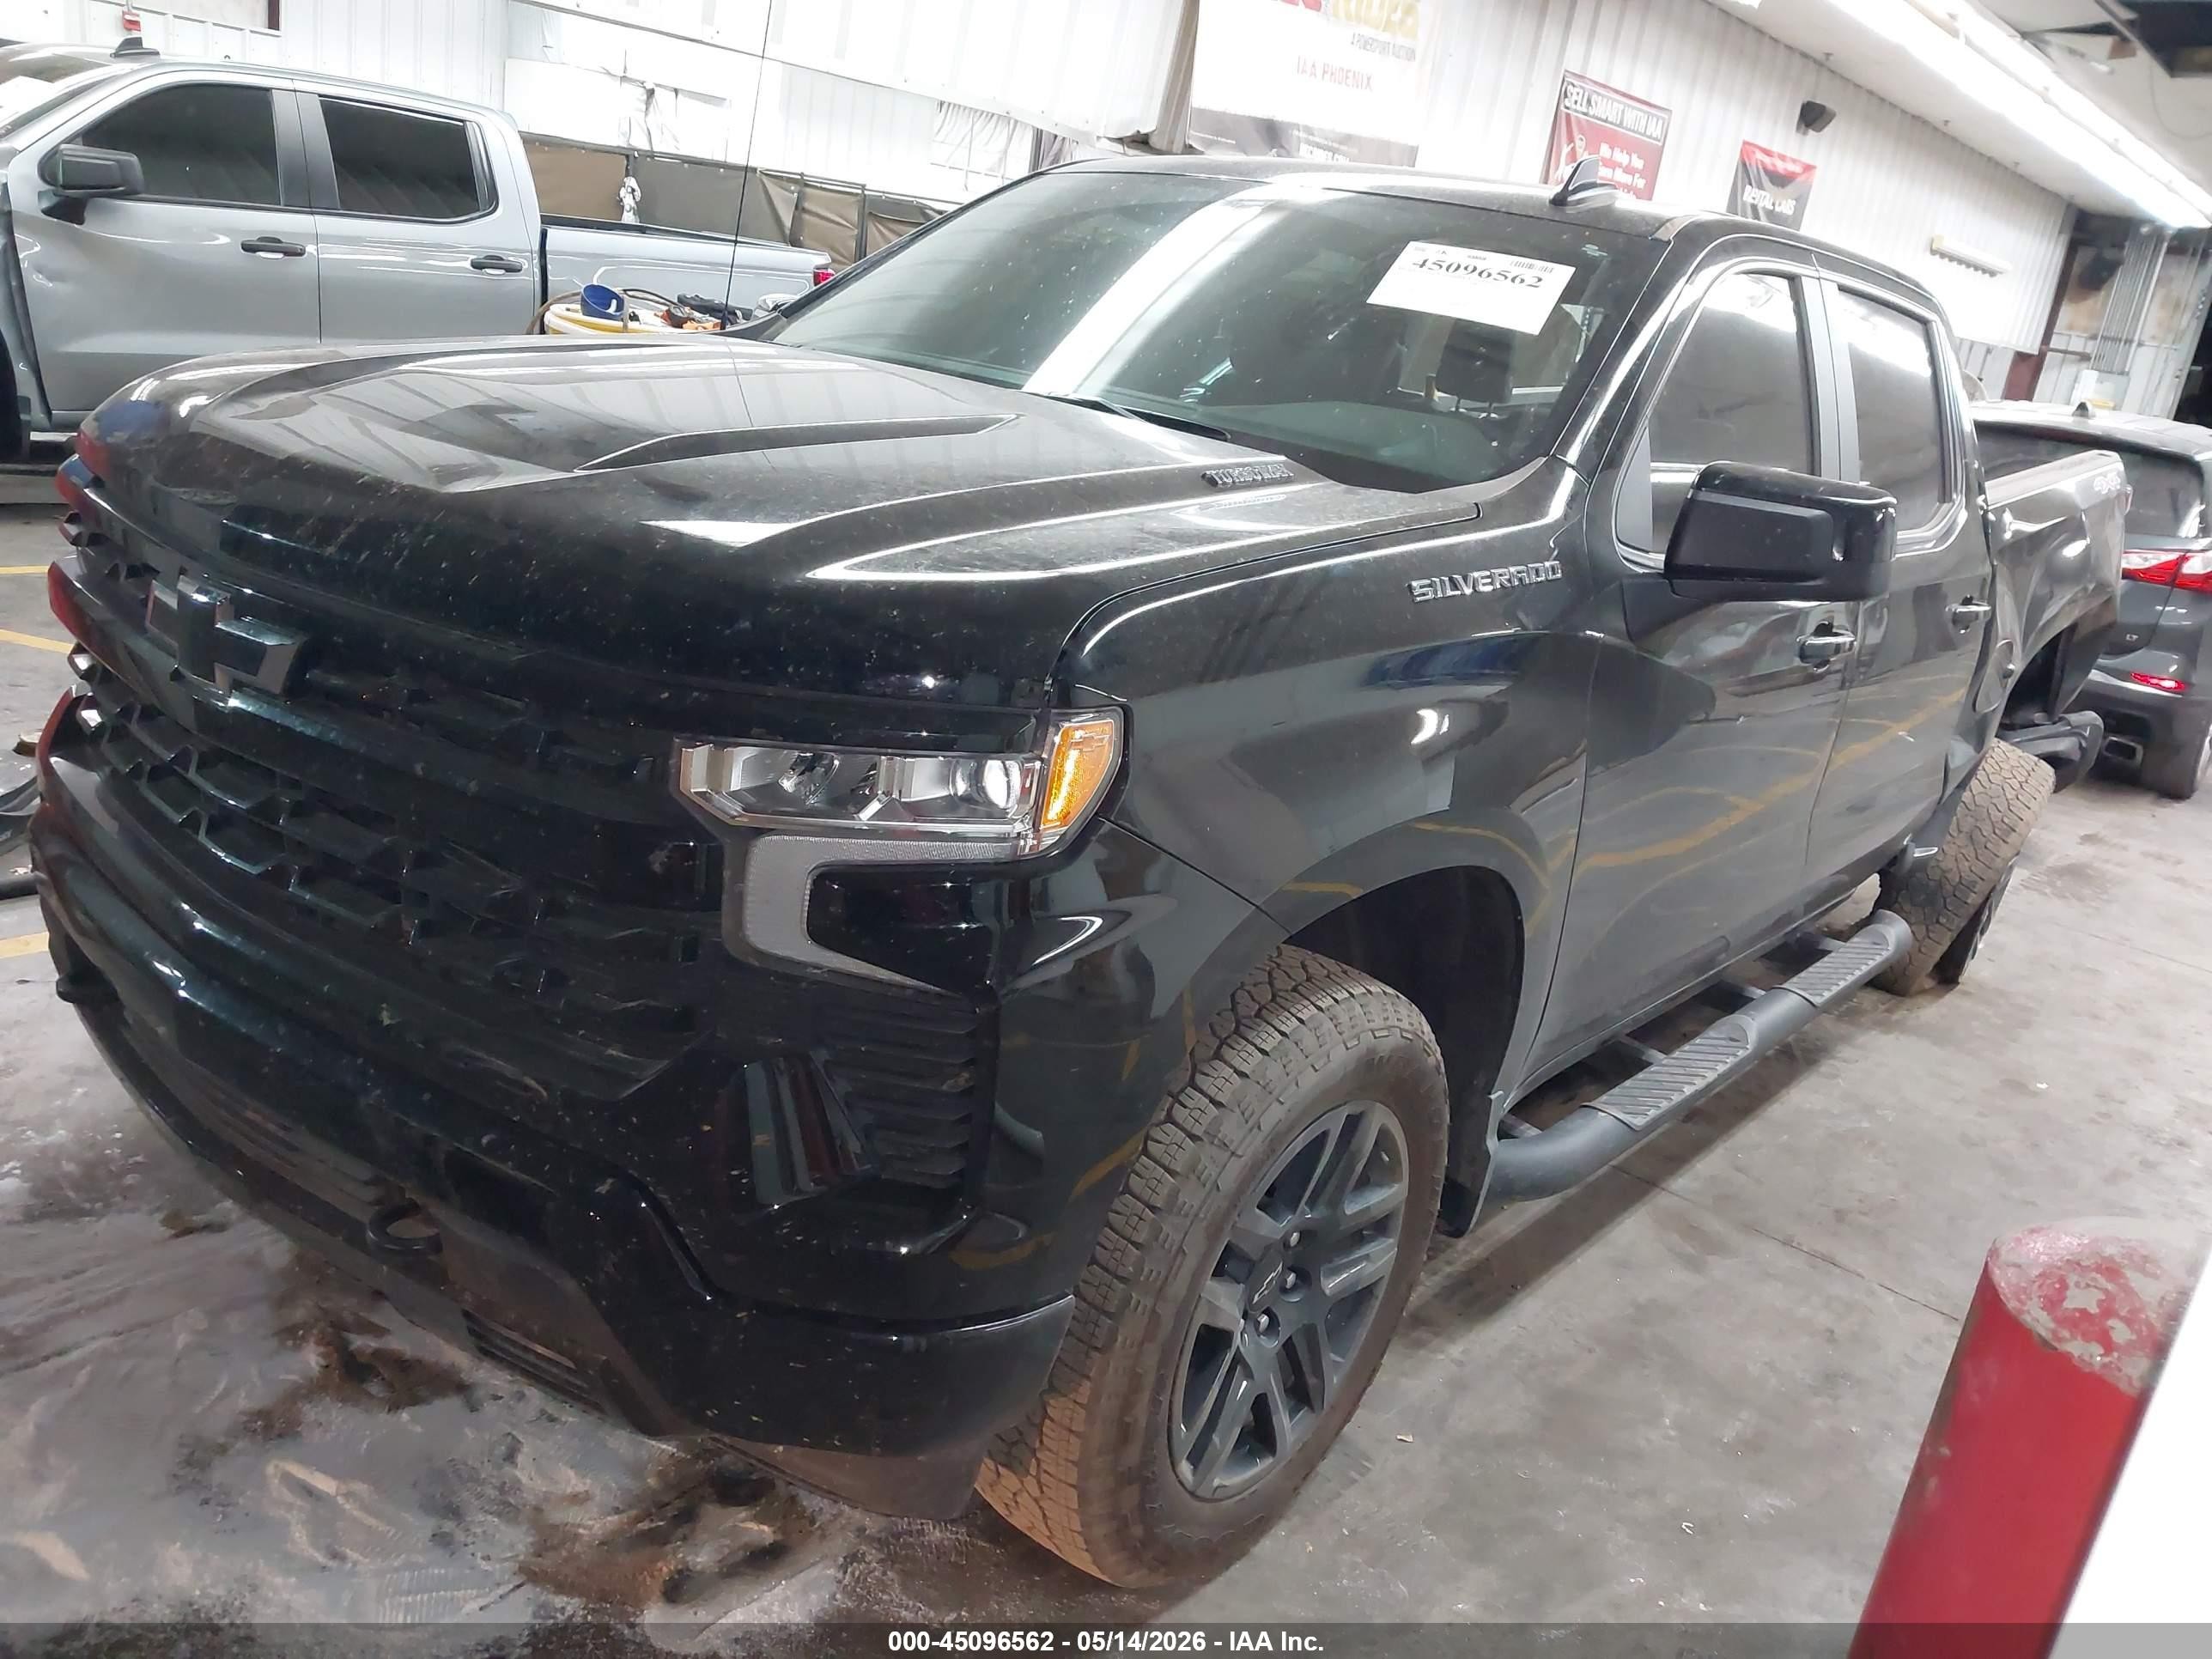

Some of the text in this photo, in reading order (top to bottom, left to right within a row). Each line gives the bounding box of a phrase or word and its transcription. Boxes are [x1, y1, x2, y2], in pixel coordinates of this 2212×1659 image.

[1297, 55, 1374, 92] IAA PHOENIX
[1565, 85, 1663, 138] SELL SMART WITH IAA
[1413, 258, 1544, 289] 45096562
[1409, 560, 1563, 603] SILVERADO
